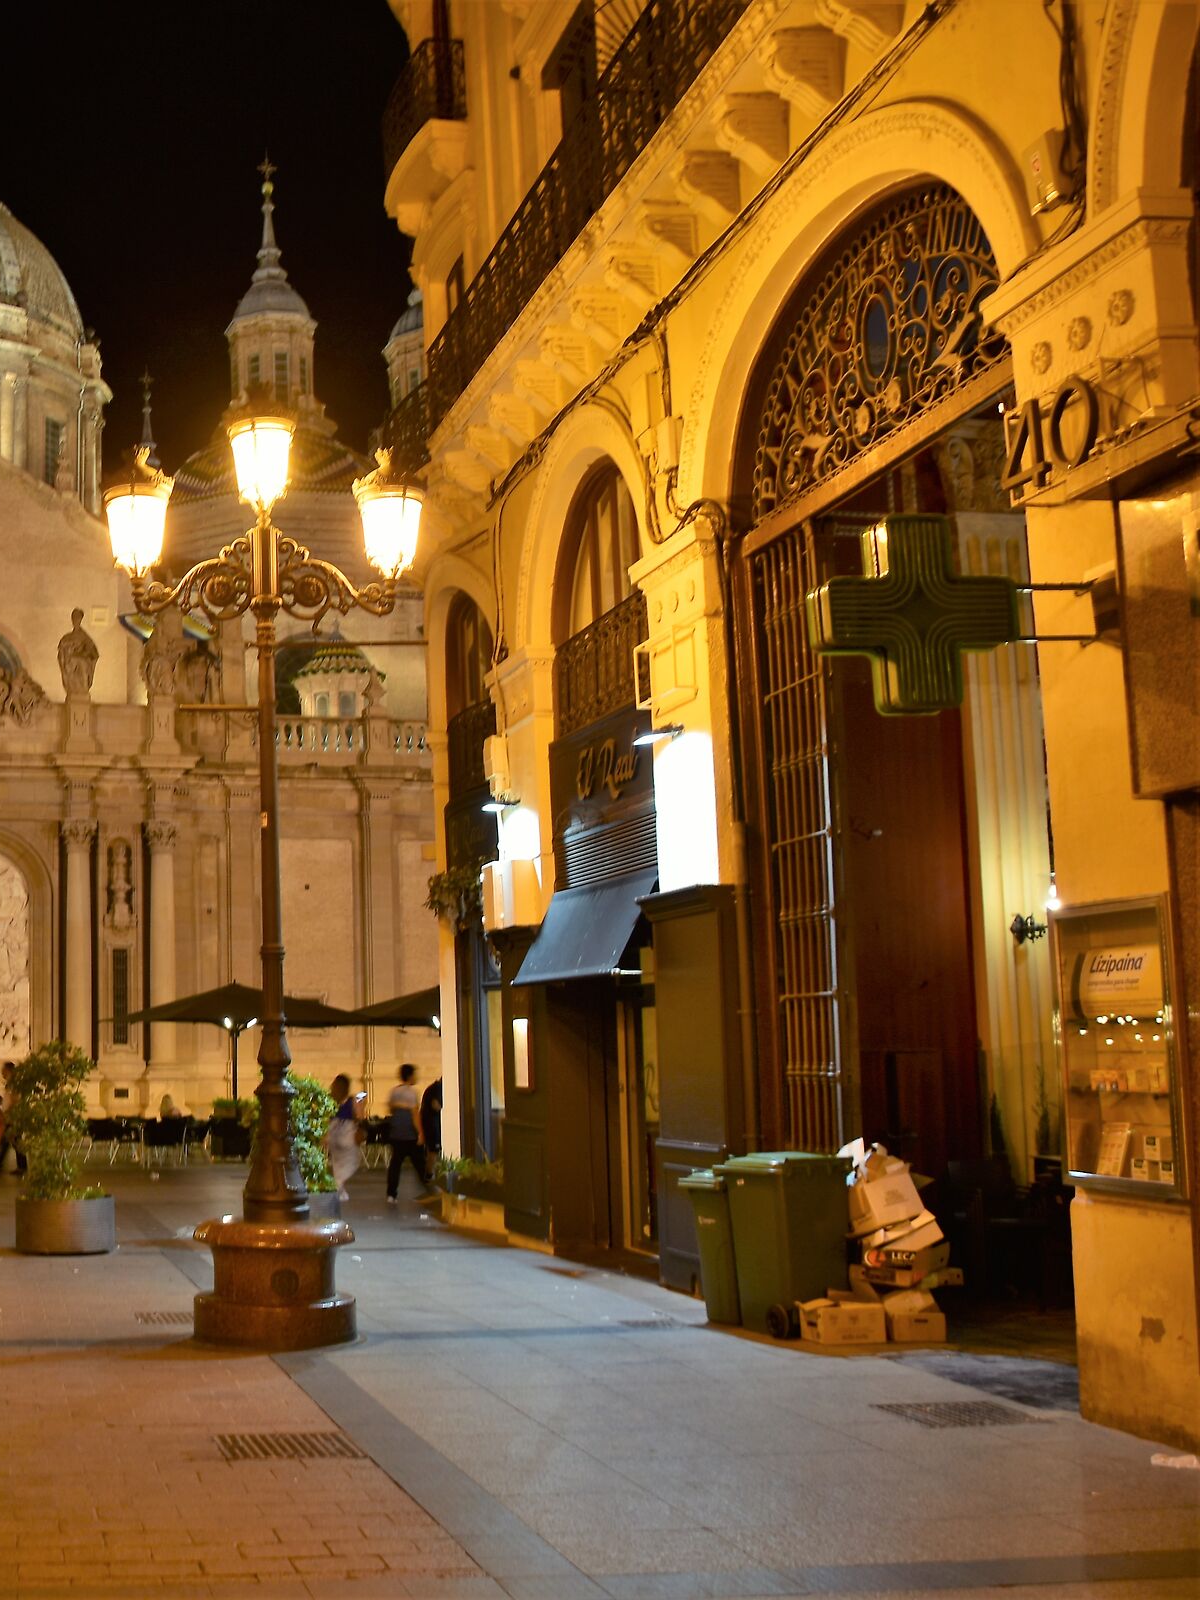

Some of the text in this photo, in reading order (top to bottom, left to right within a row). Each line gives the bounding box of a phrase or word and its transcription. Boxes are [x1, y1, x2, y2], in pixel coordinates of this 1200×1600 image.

[1001, 374, 1100, 490] 40
[576, 733, 638, 801] El Real
[1089, 953, 1143, 976] Lizipaina
